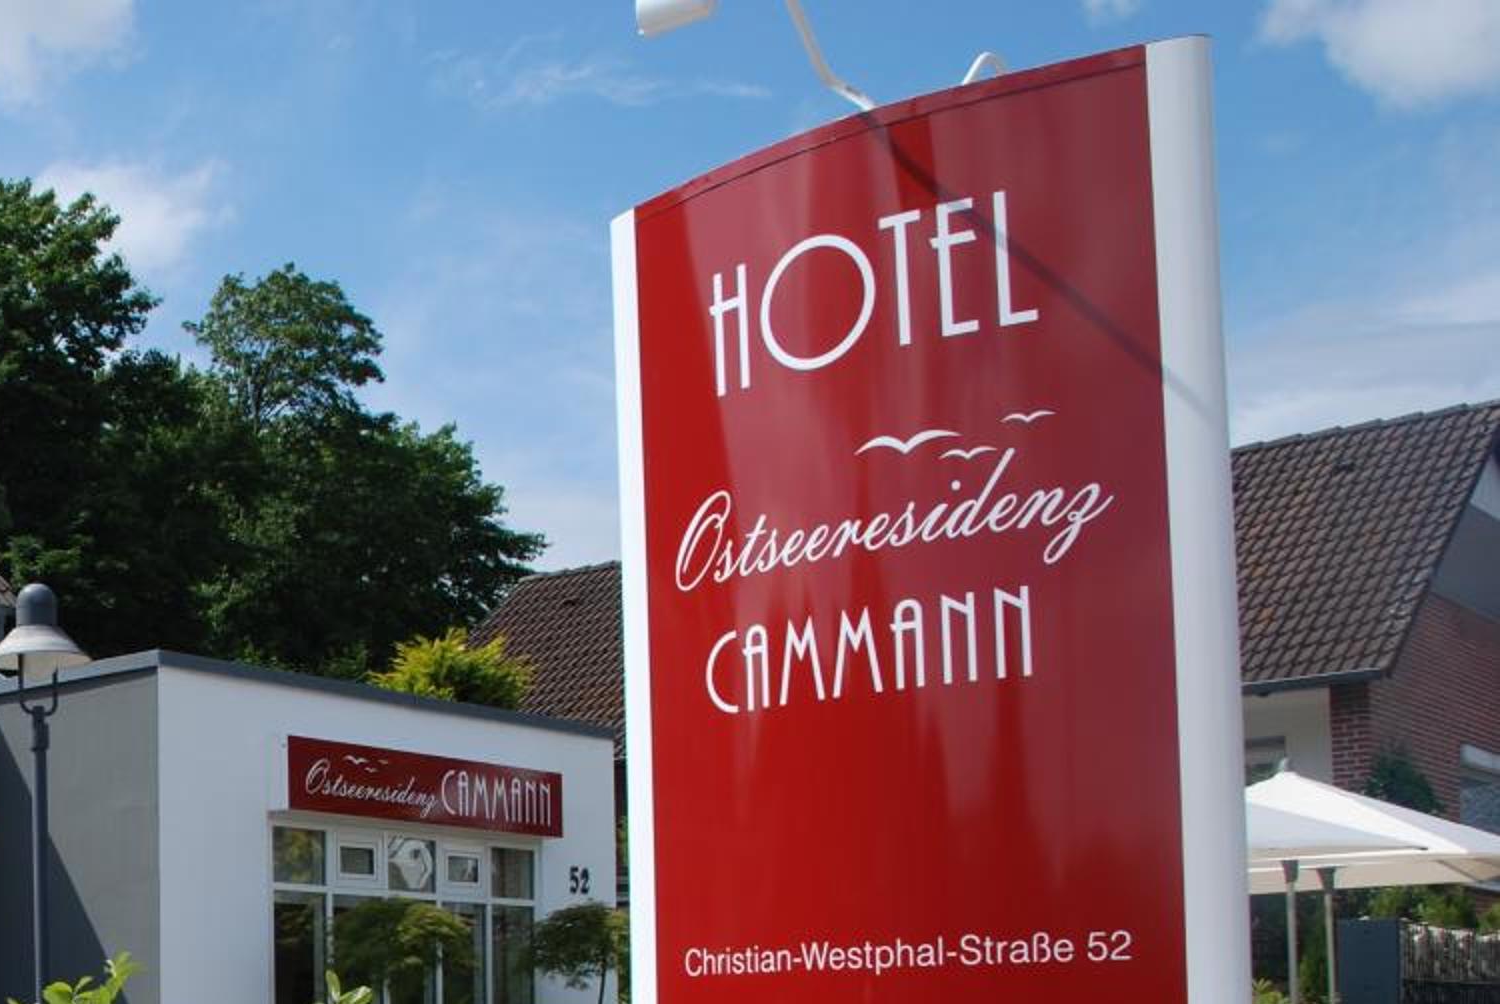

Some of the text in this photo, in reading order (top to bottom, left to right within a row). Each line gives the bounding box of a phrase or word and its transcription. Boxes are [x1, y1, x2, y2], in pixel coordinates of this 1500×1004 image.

[709, 190, 1039, 397] HOTEL
[674, 447, 1114, 592] Ostseeresidenz
[705, 585, 1033, 713] CAMMANN
[305, 758, 551, 826] Ostseeresidenz CAMMANN
[569, 866, 590, 894] 52
[684, 929, 1133, 977] Christian-Westphal-Straße 52
